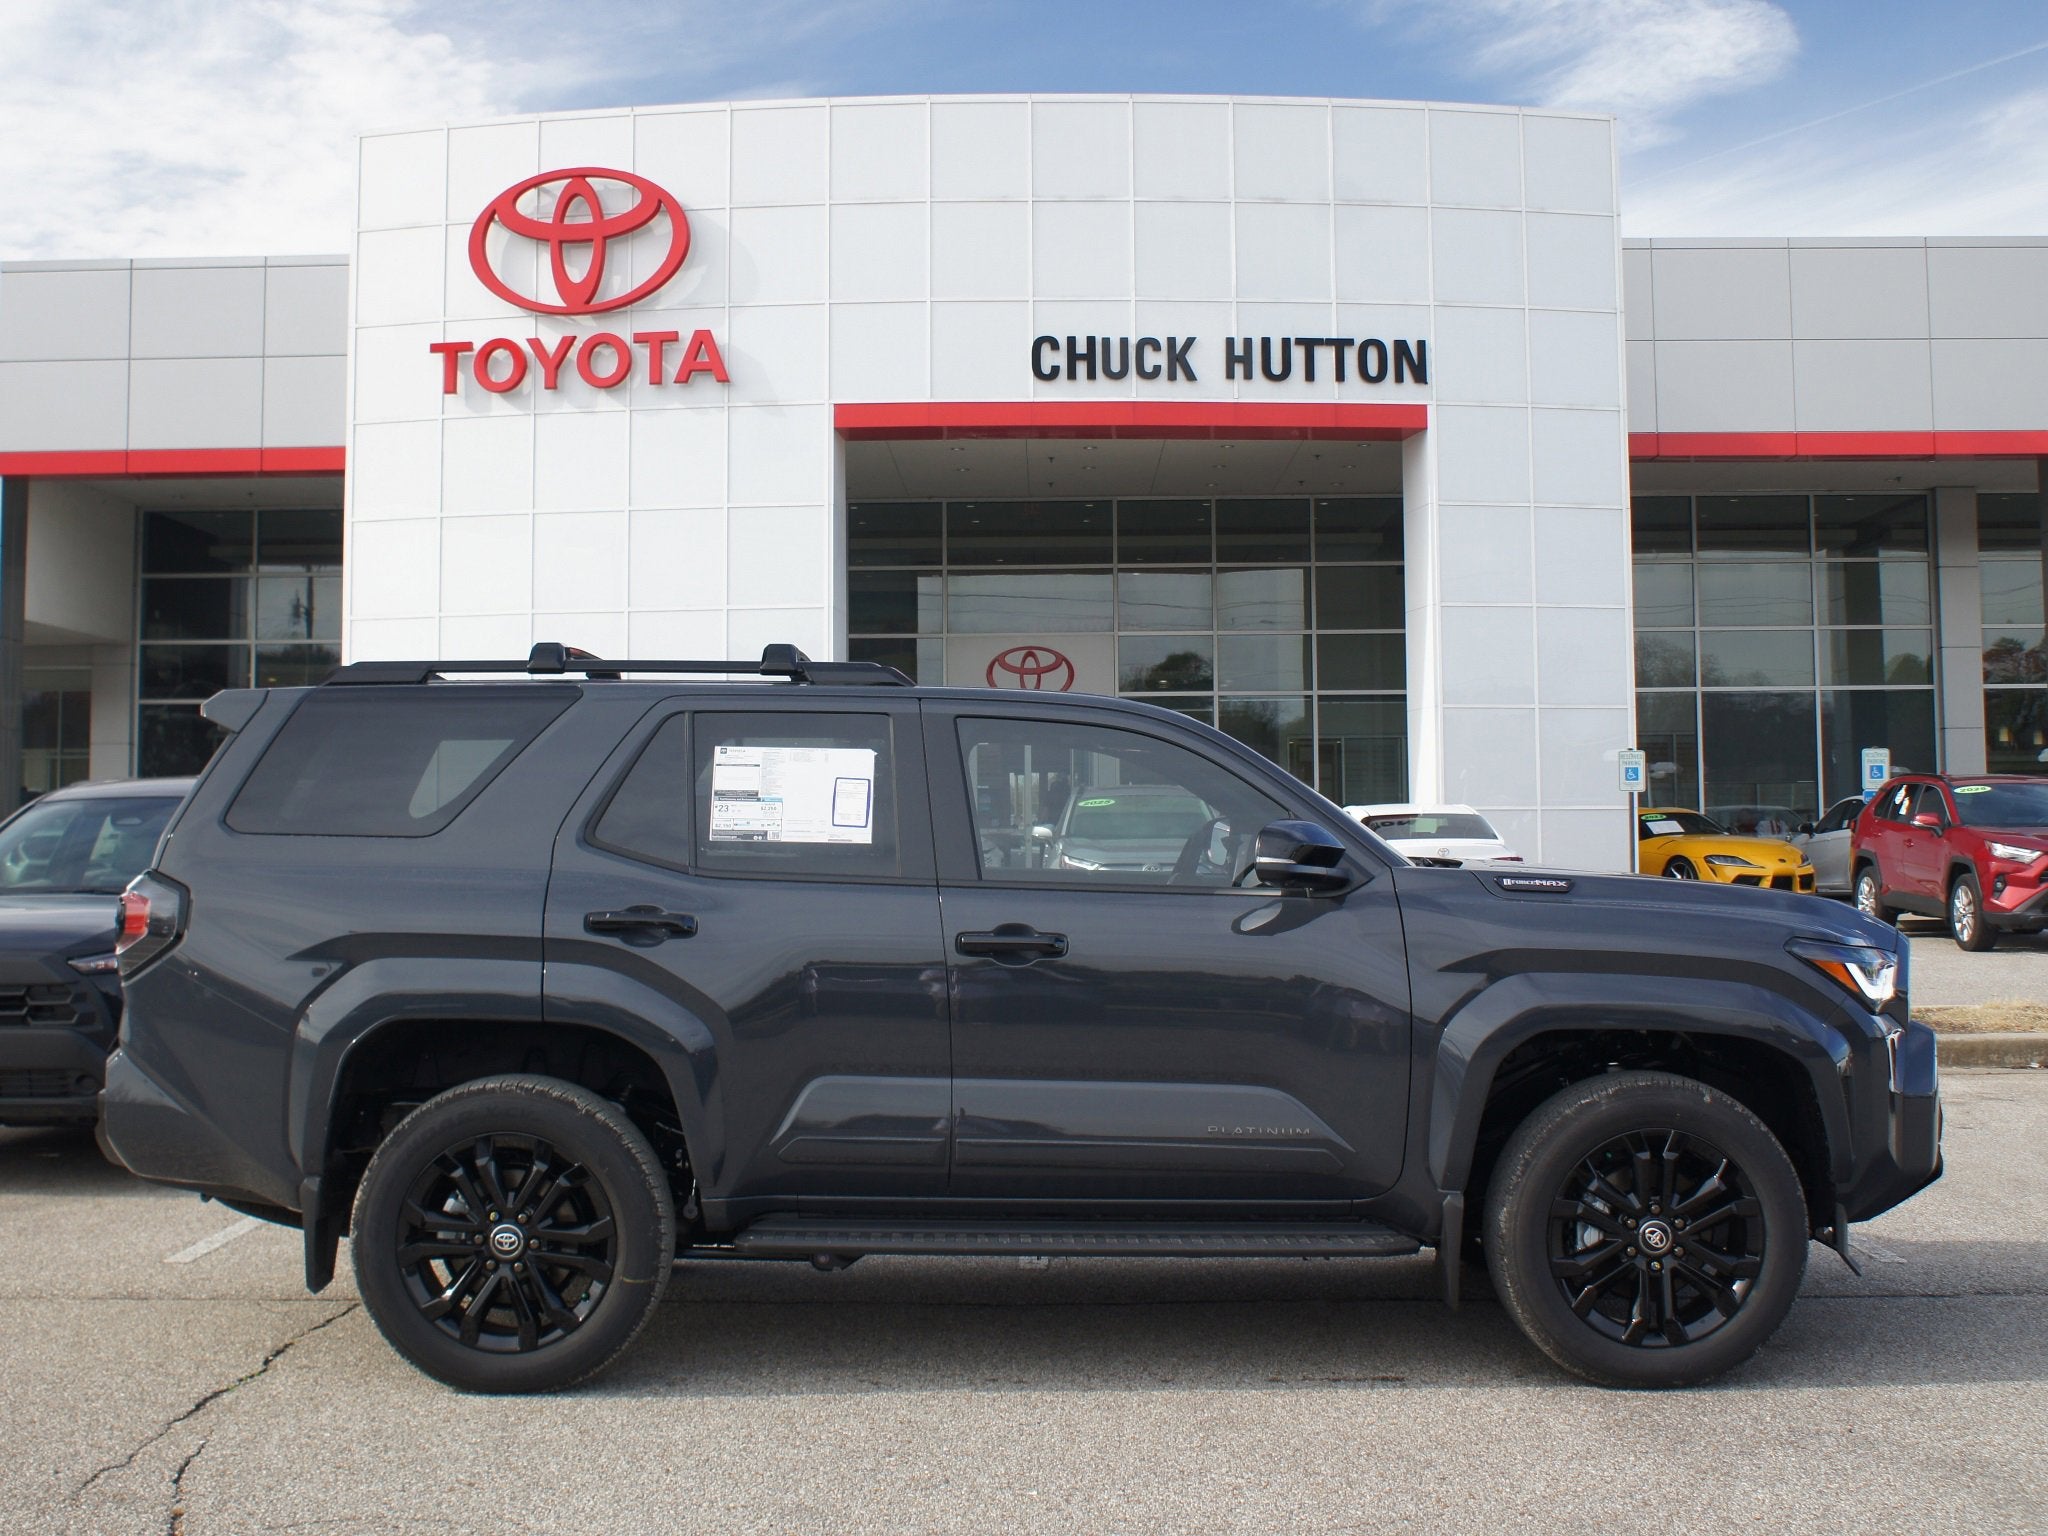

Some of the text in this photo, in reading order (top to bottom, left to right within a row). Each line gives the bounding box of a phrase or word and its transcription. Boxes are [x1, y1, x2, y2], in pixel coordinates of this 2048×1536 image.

[430, 329, 730, 394] TOYOTA
[1031, 335, 1428, 385] CHUCK HUTTON
[718, 804, 729, 813] 23
[1207, 1125, 1311, 1135] PLATINUM
